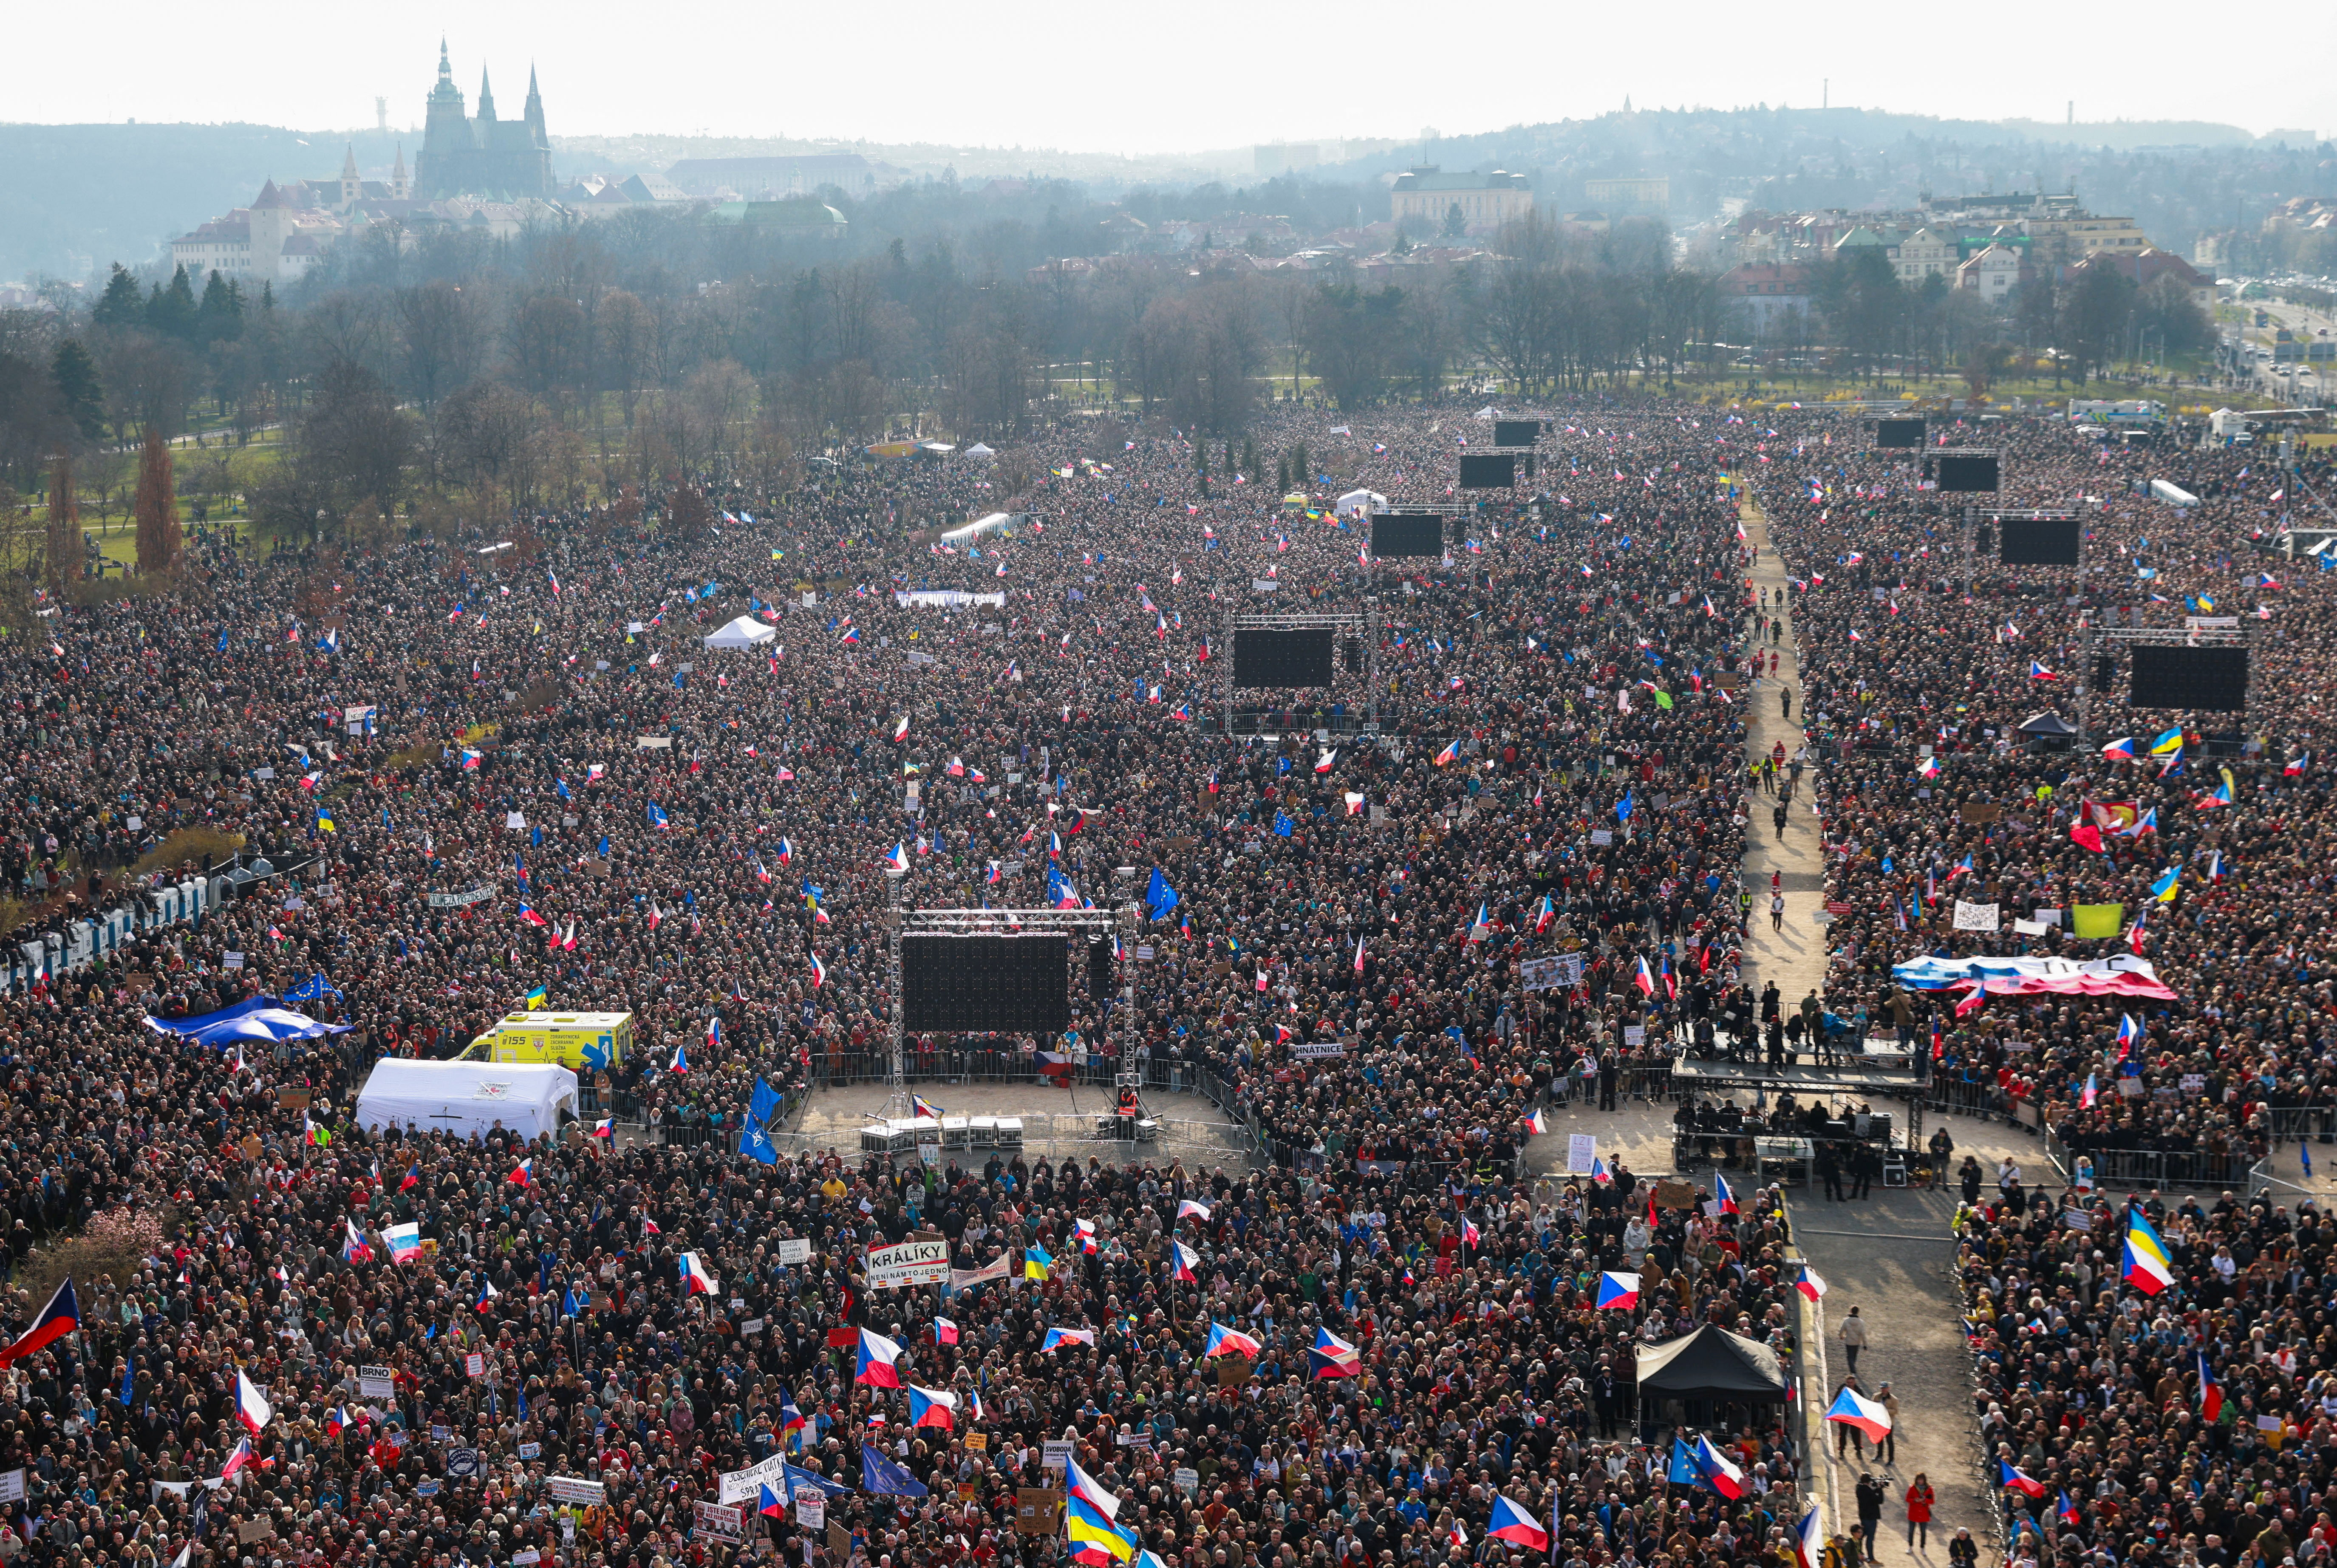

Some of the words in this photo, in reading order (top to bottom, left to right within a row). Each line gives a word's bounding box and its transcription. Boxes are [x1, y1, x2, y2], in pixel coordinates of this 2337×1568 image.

[457, 886, 496, 904] PREZIDENTEM
[804, 1006, 813, 1019] P2
[508, 1036, 526, 1045] 155
[1296, 1045, 1341, 1054] HNÁTNICE
[914, 1231, 939, 1240] POLITIKA
[872, 1245, 941, 1268] KRÁLÍKY
[871, 1273, 889, 1281] NENÍ
[890, 1271, 907, 1279] NÁM
[908, 1269, 918, 1277] TO
[920, 1267, 947, 1276] JEDNO
[979, 1265, 1006, 1276] DEMOKRACII!
[742, 1322, 762, 1330] OLOMOUC
[362, 1367, 389, 1377] BRNO
[558, 1494, 586, 1504] ŠPINDLERŮV
[196, 1503, 204, 1526] P1
[707, 1506, 719, 1515] JSTE
[710, 1533, 736, 1543] nepotřebujete
